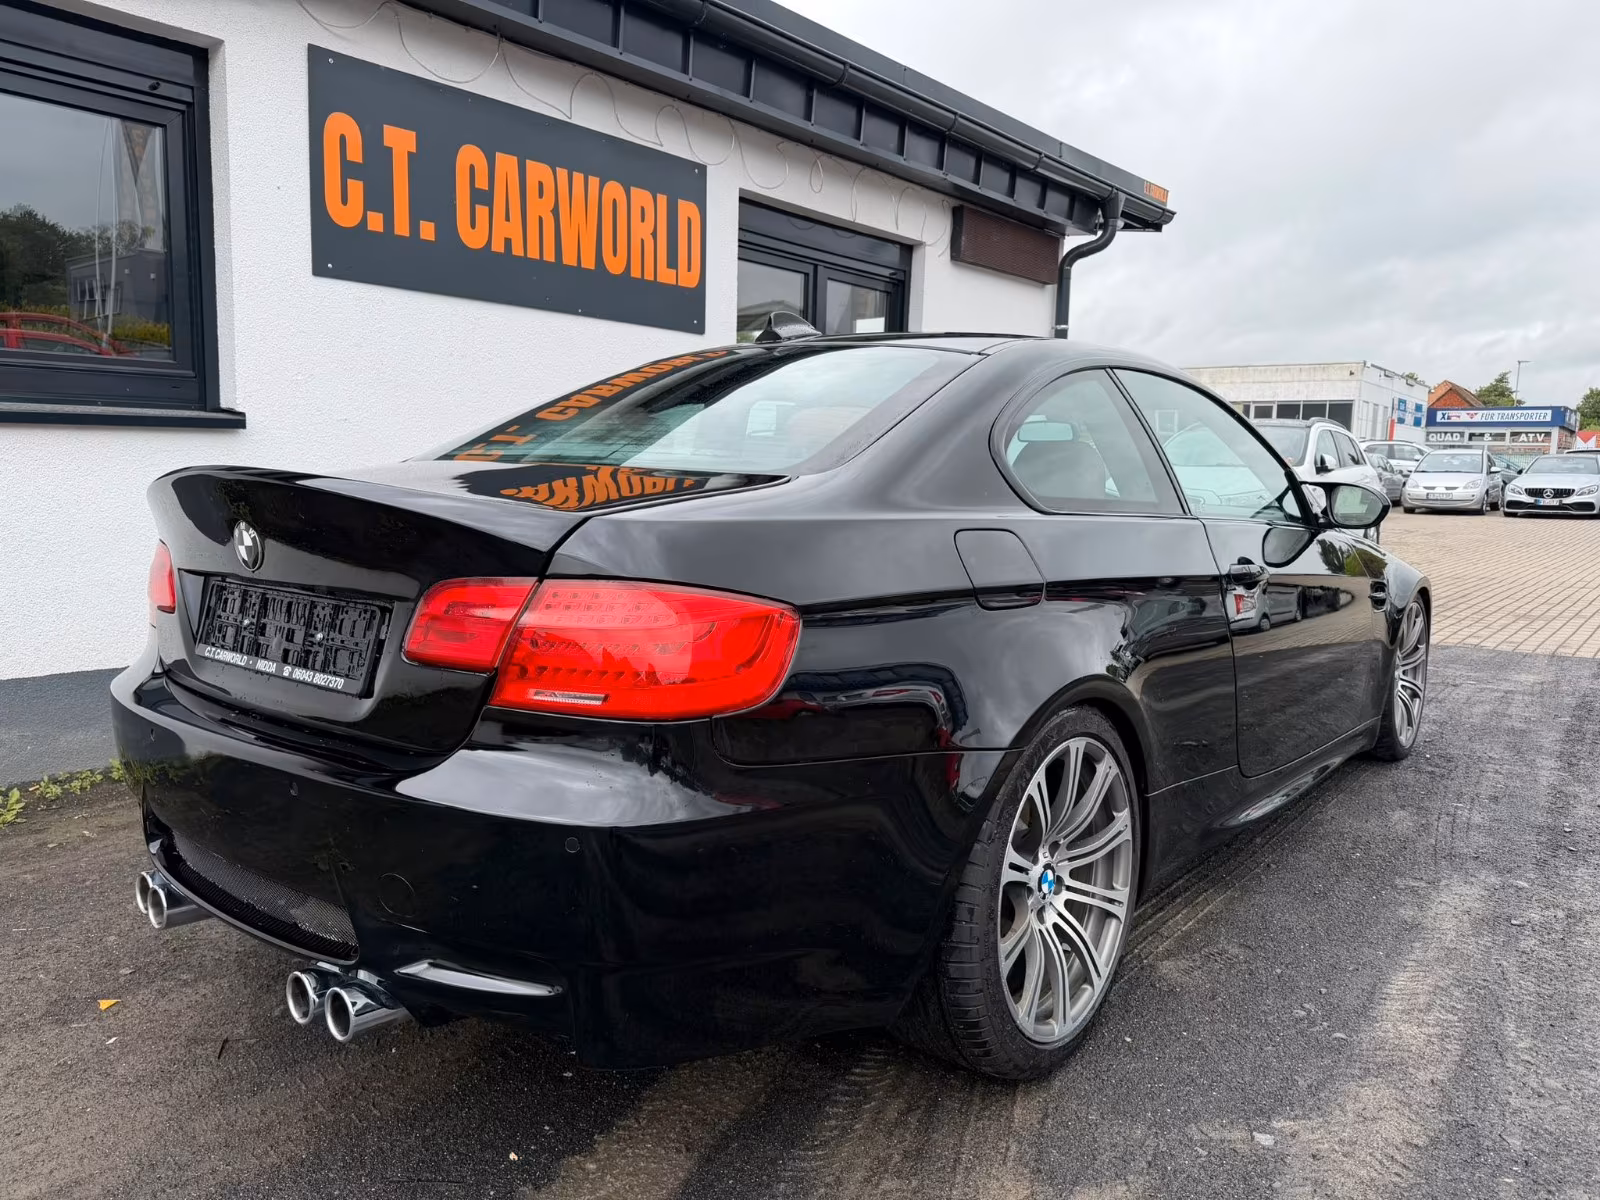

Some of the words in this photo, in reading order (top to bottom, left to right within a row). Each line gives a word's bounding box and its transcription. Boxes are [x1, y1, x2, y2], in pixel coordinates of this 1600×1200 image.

[323, 111, 436, 241] C.T.
[456, 144, 701, 289] CARWORLD
[1496, 411, 1548, 421] TRANSPORTER
[1428, 432, 1461, 442] QUAD
[1518, 433, 1546, 442] ATV
[255, 658, 277, 674] NIDDA
[292, 667, 313, 682] 06043
[312, 672, 345, 690] 8027370
